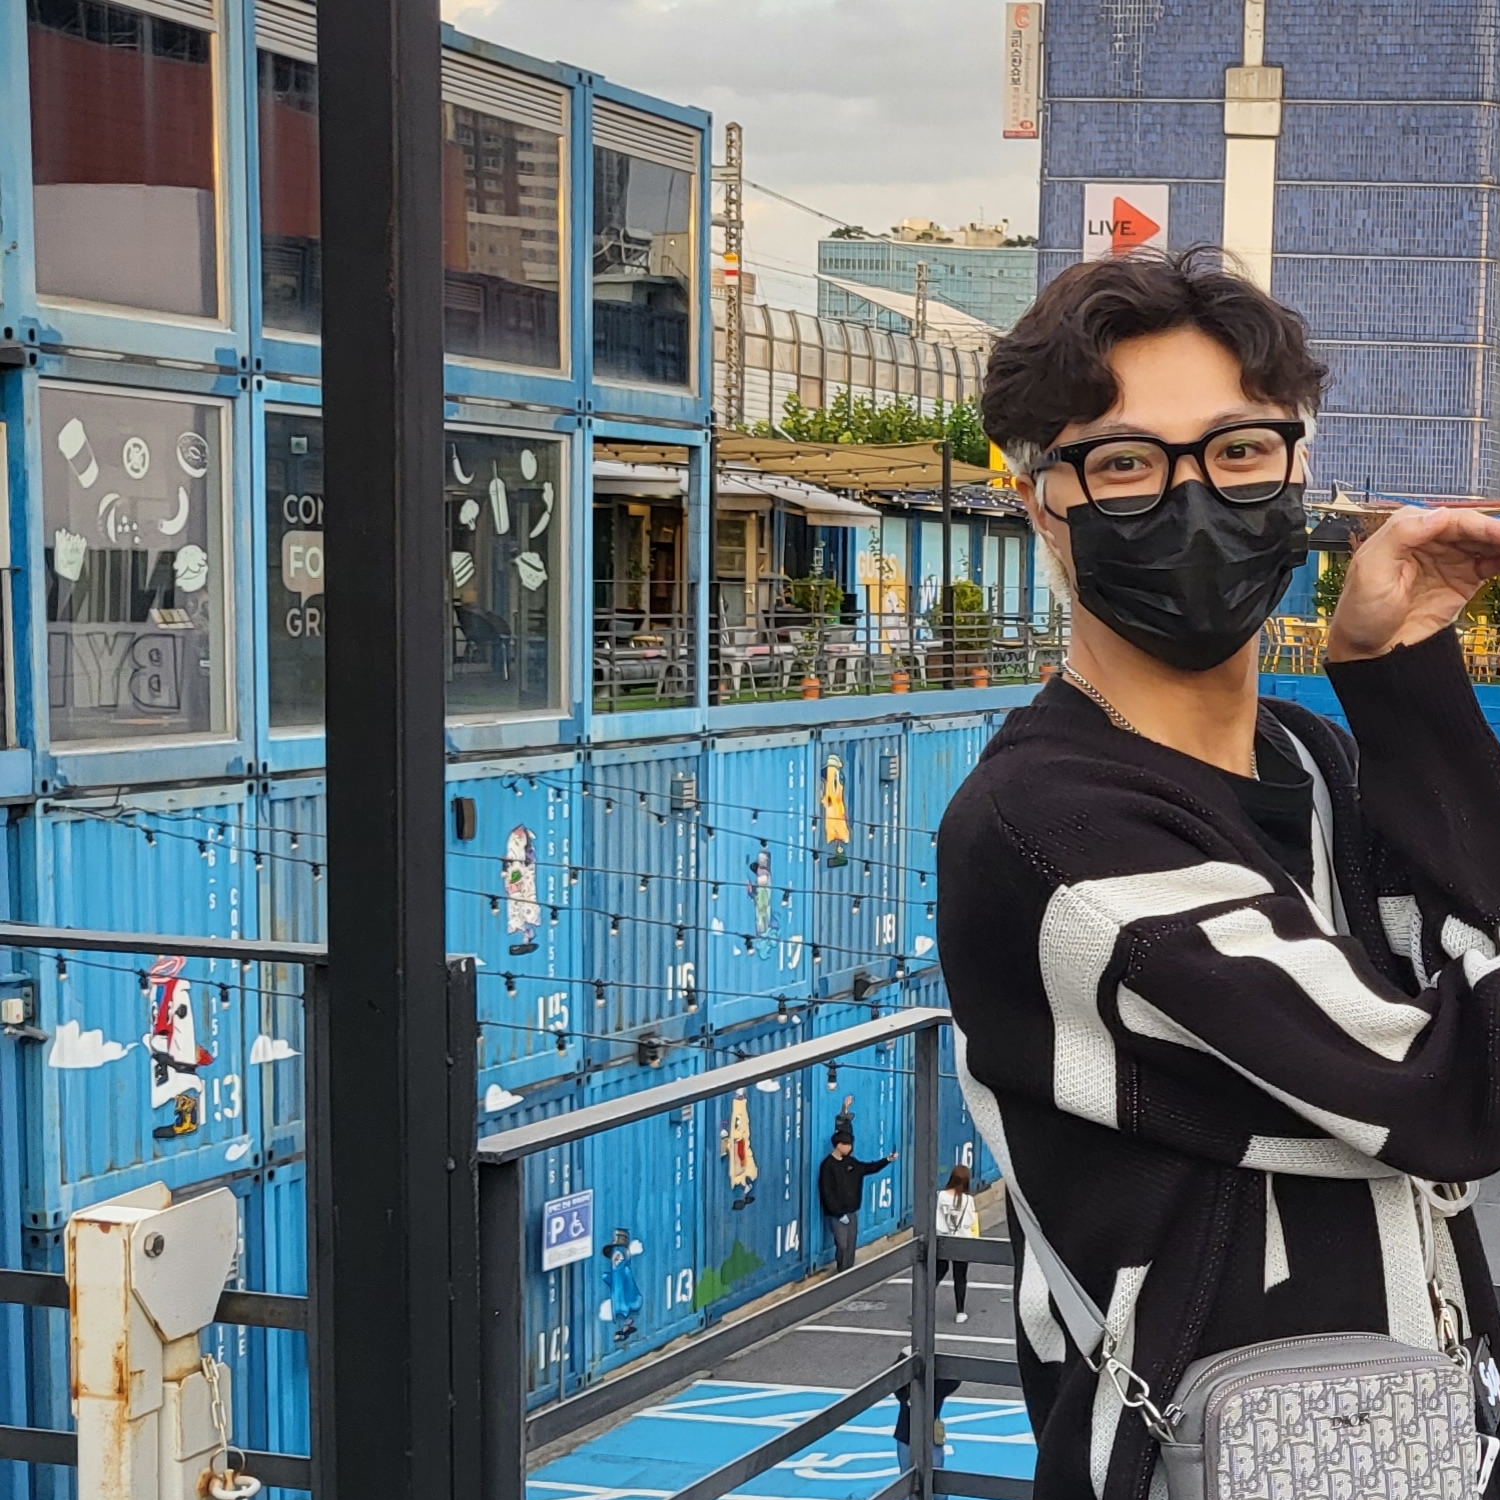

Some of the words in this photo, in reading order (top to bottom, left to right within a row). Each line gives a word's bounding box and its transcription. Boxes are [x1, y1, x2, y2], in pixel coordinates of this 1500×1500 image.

[875, 913, 896, 947] 18
[666, 962, 696, 1001] 16
[538, 991, 569, 1035] 15
[871, 1177, 892, 1214] 15
[551, 1216, 565, 1244] P
[775, 1219, 800, 1259] 14
[666, 1268, 694, 1311] 13
